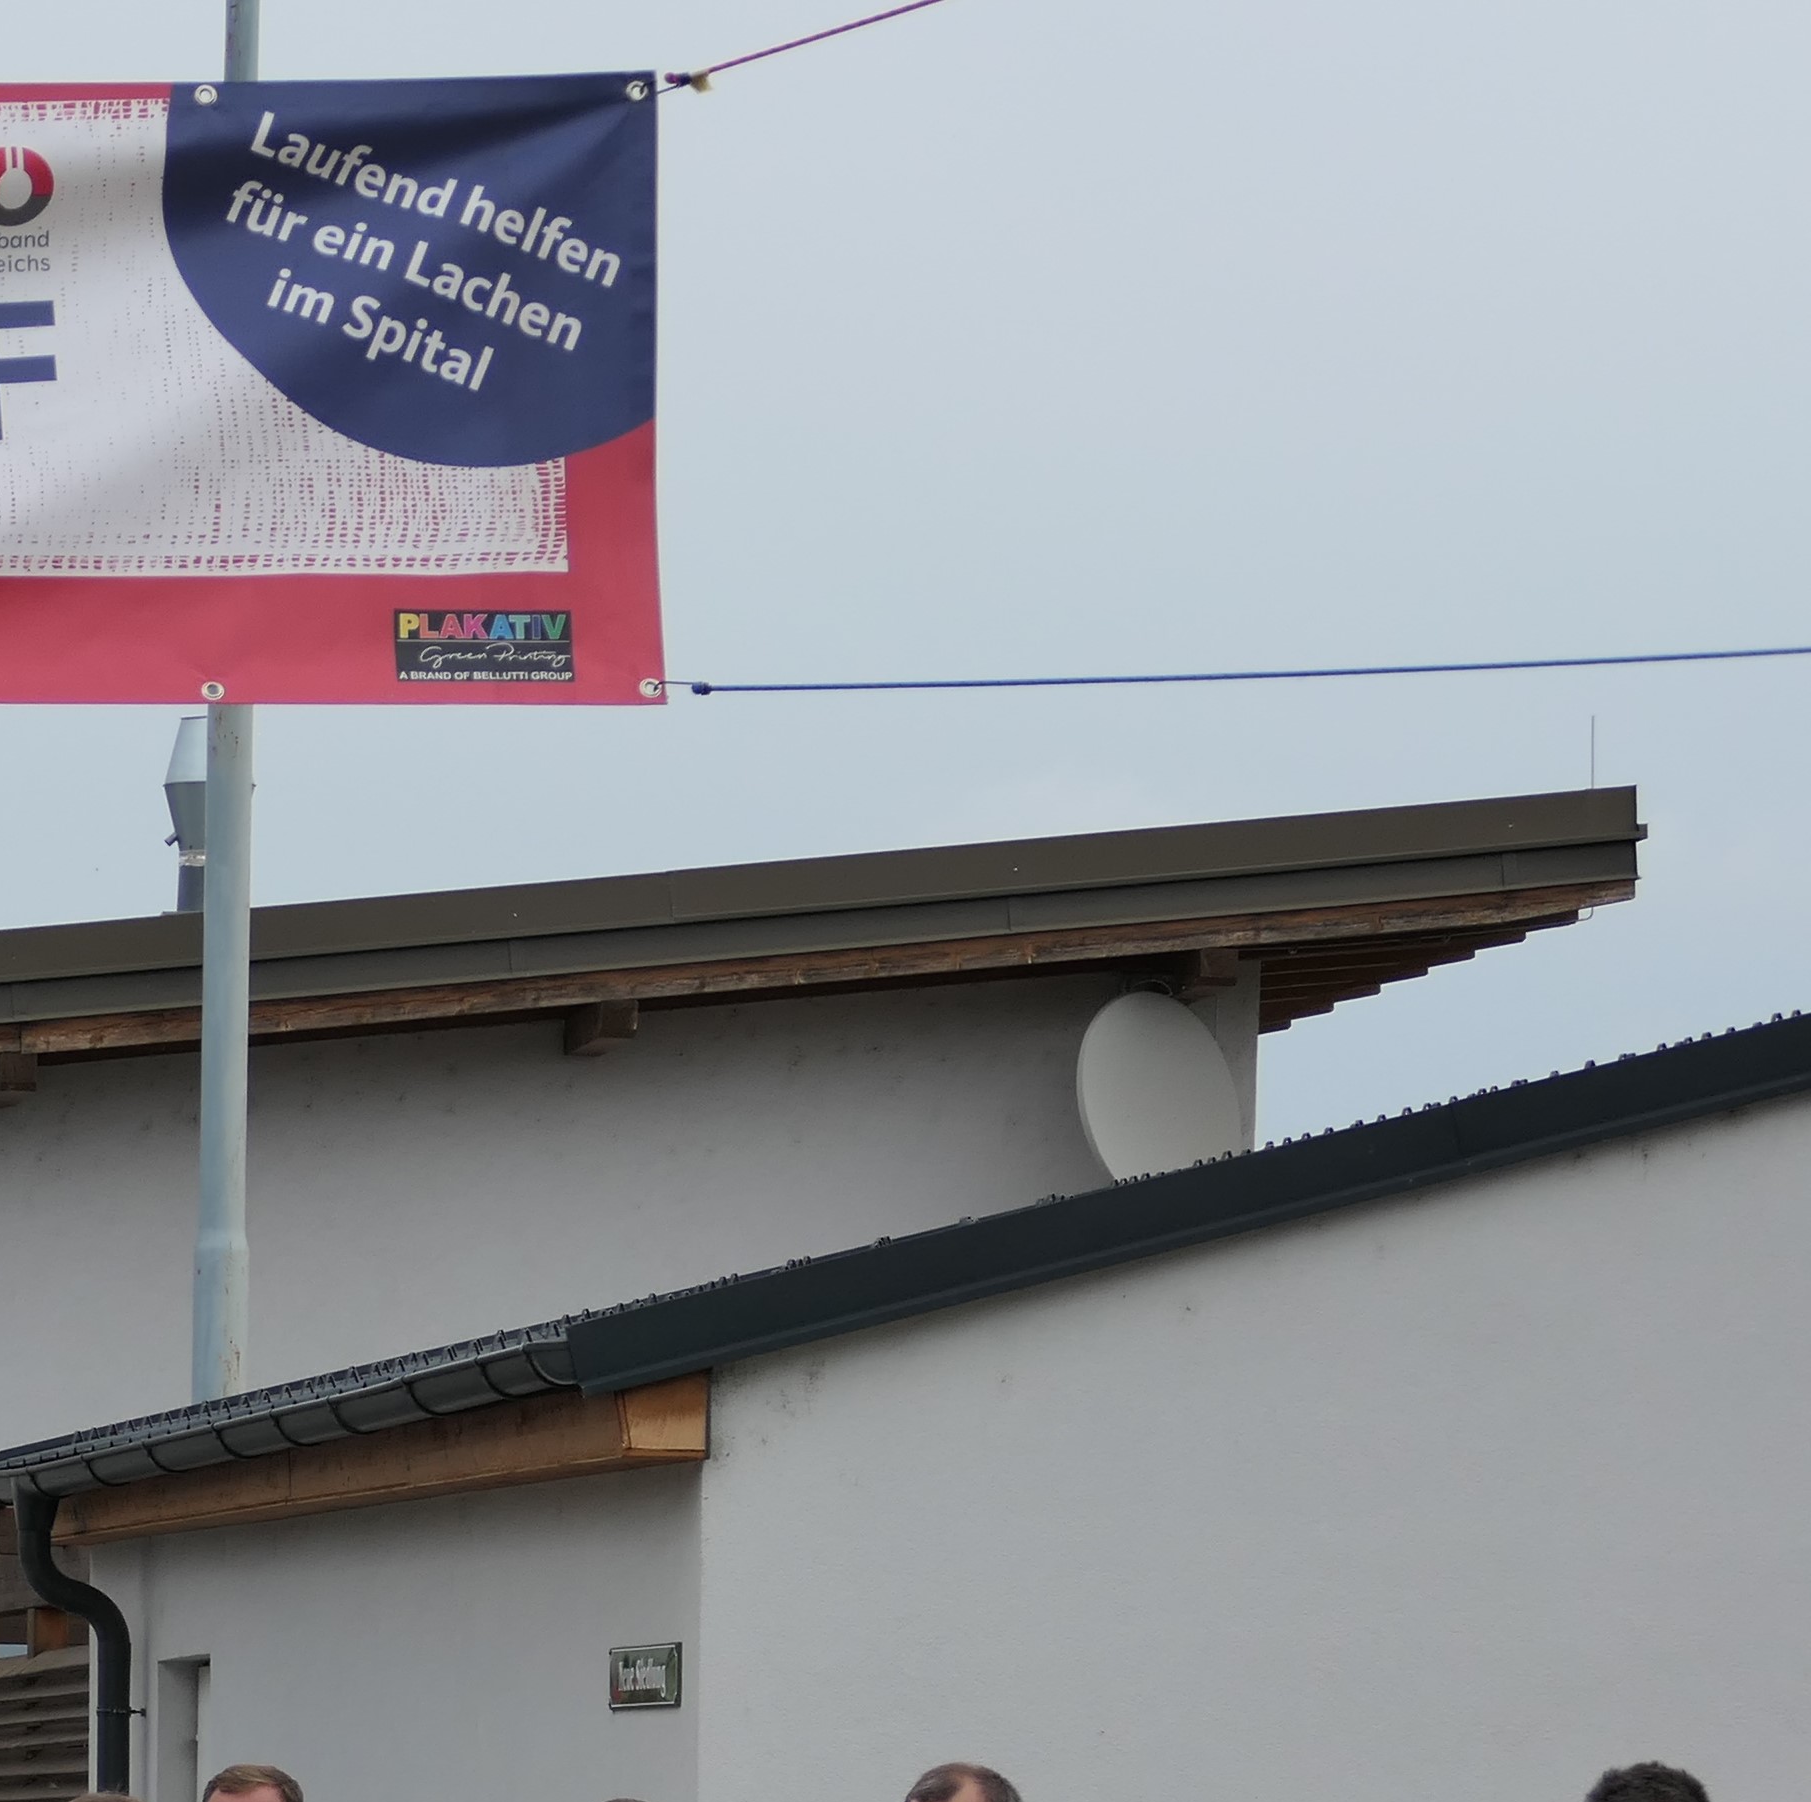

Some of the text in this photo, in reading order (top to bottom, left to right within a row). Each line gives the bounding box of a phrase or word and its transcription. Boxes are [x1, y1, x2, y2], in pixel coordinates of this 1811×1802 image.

[251, 111, 620, 288] Laufend helfen
[227, 180, 582, 351] für ein Lachen
[267, 268, 494, 391] im Spital
[399, 613, 566, 640] PLAKATIV
[420, 646, 488, 668] Green
[399, 671, 572, 680] A BRAND OF BELLUTTI GROUP
